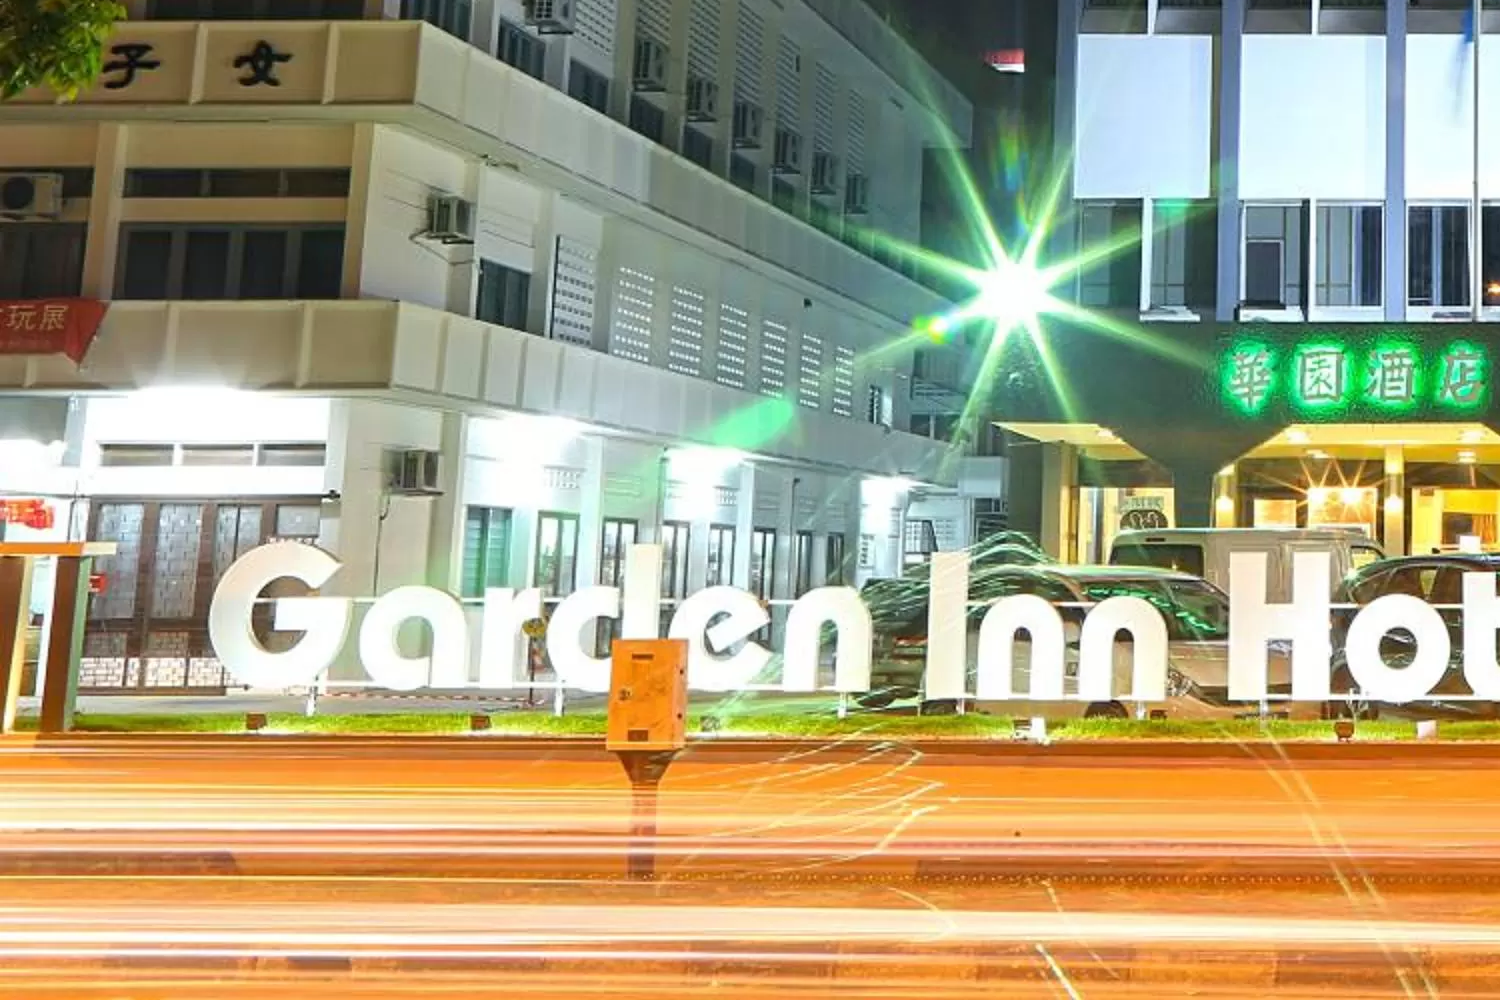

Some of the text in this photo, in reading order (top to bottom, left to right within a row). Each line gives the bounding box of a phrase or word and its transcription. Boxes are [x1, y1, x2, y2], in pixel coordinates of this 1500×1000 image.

[0, 304, 70, 331] 玩展
[1228, 345, 1486, 409] 華園酒店
[208, 541, 873, 692] Garden
[924, 550, 1170, 703] Inn
